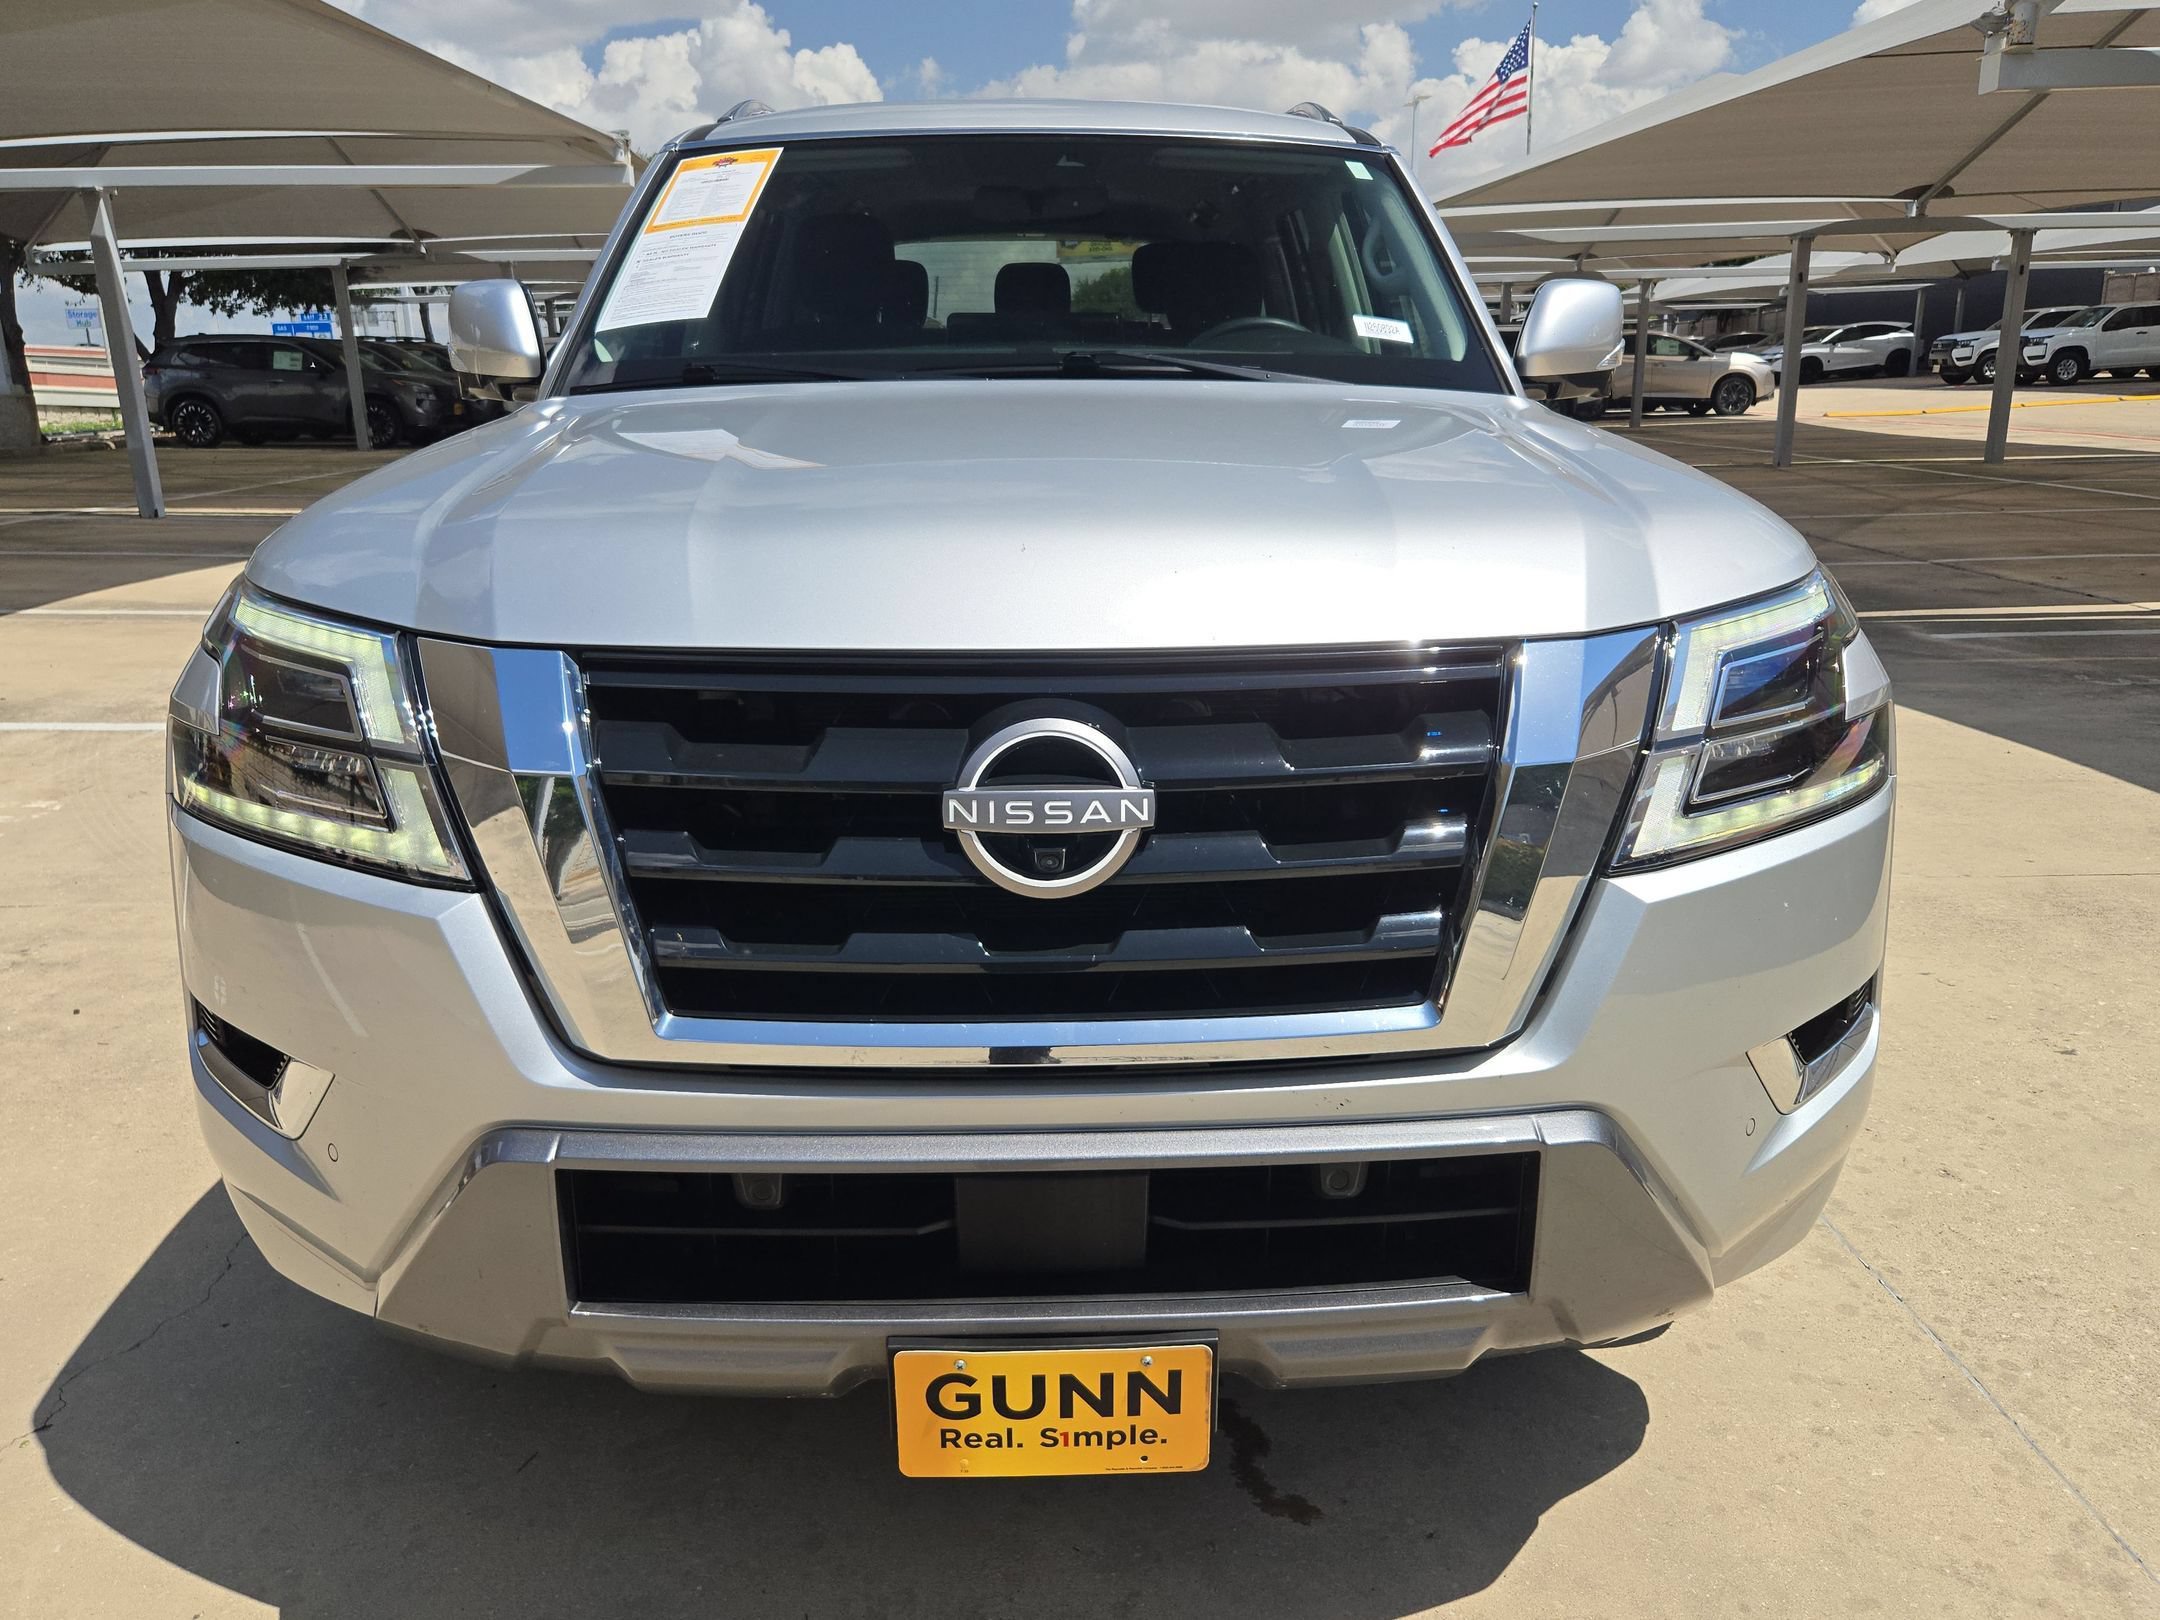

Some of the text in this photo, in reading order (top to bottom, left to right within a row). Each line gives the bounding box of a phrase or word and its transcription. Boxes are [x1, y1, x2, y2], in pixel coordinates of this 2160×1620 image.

[67, 309, 97, 320] Storage
[949, 798, 1149, 825] NISSAN
[925, 1369, 1183, 1421] GUNN
[940, 1428, 1024, 1449] Real.
